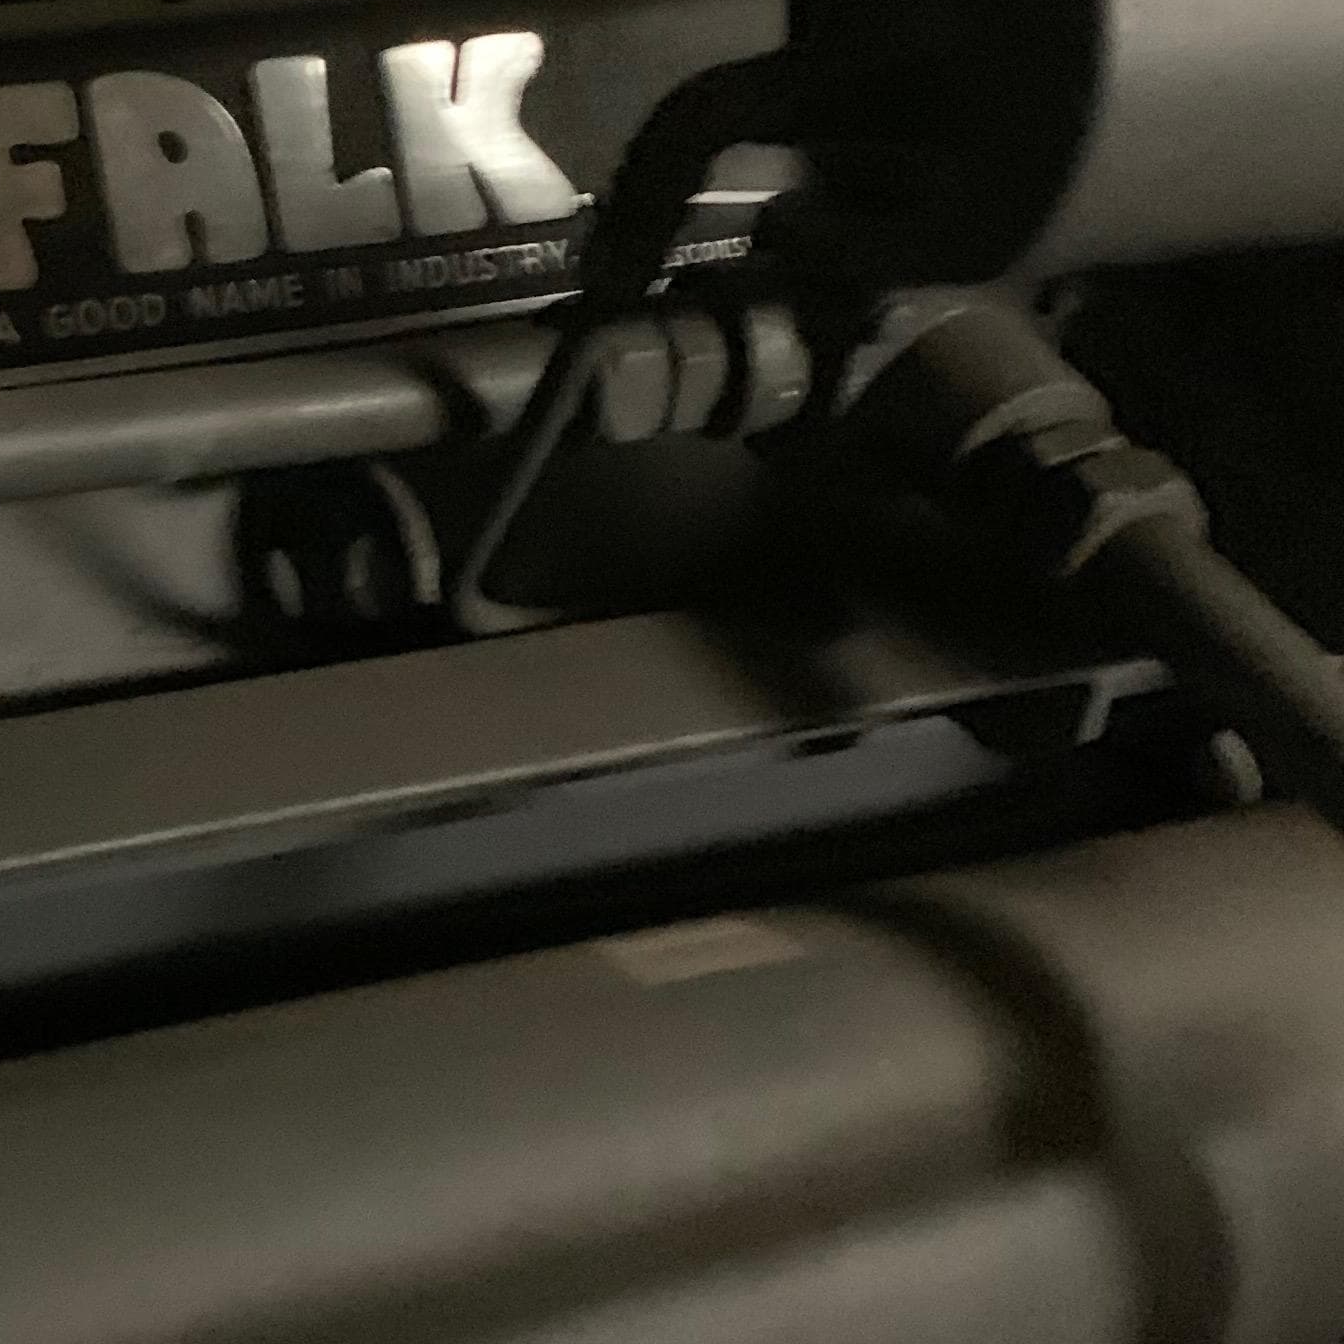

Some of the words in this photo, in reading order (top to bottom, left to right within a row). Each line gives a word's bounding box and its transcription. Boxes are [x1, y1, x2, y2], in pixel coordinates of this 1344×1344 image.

[42, 295, 167, 340] GOOD
[185, 271, 305, 319] NAME
[324, 264, 364, 302] IN
[387, 238, 569, 292] INDUSTRY
